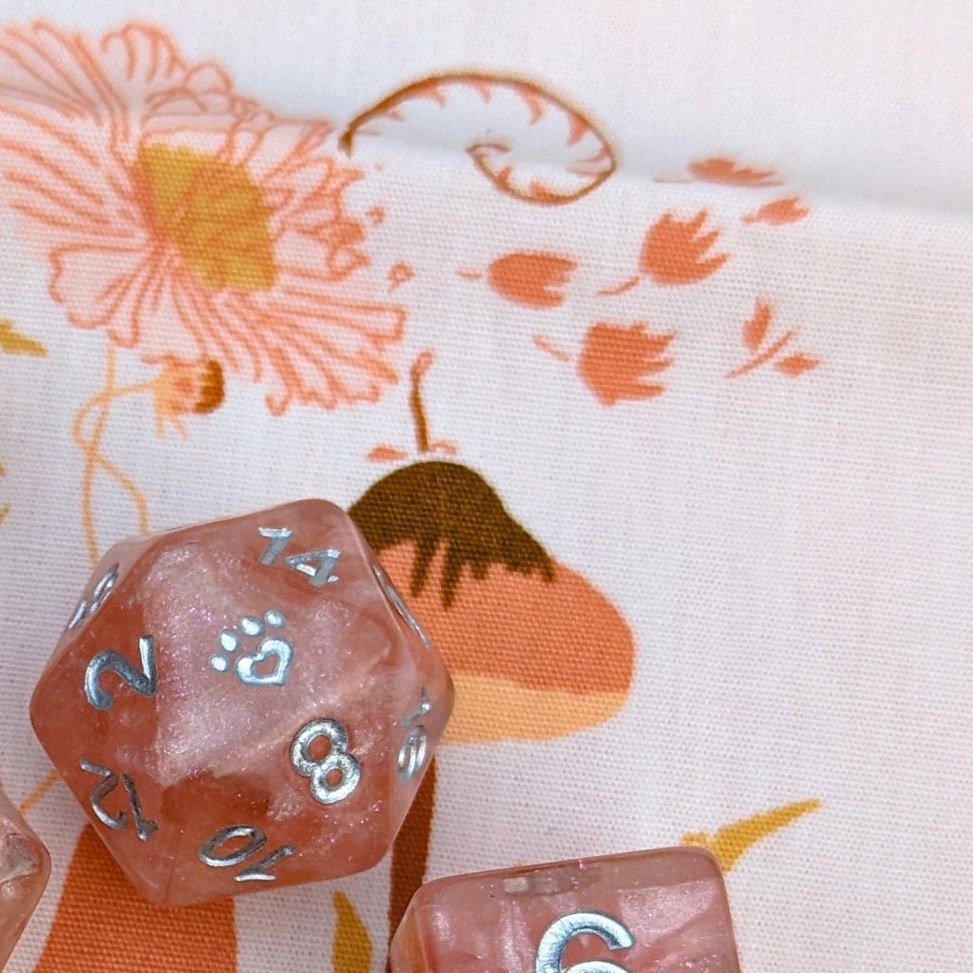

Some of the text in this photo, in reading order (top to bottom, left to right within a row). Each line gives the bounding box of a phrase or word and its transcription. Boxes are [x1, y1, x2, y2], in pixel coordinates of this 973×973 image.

[258, 526, 341, 588] 14
[83, 634, 157, 711] 2
[290, 718, 362, 805] 8
[79, 759, 159, 842] 12
[198, 824, 297, 883] 10
